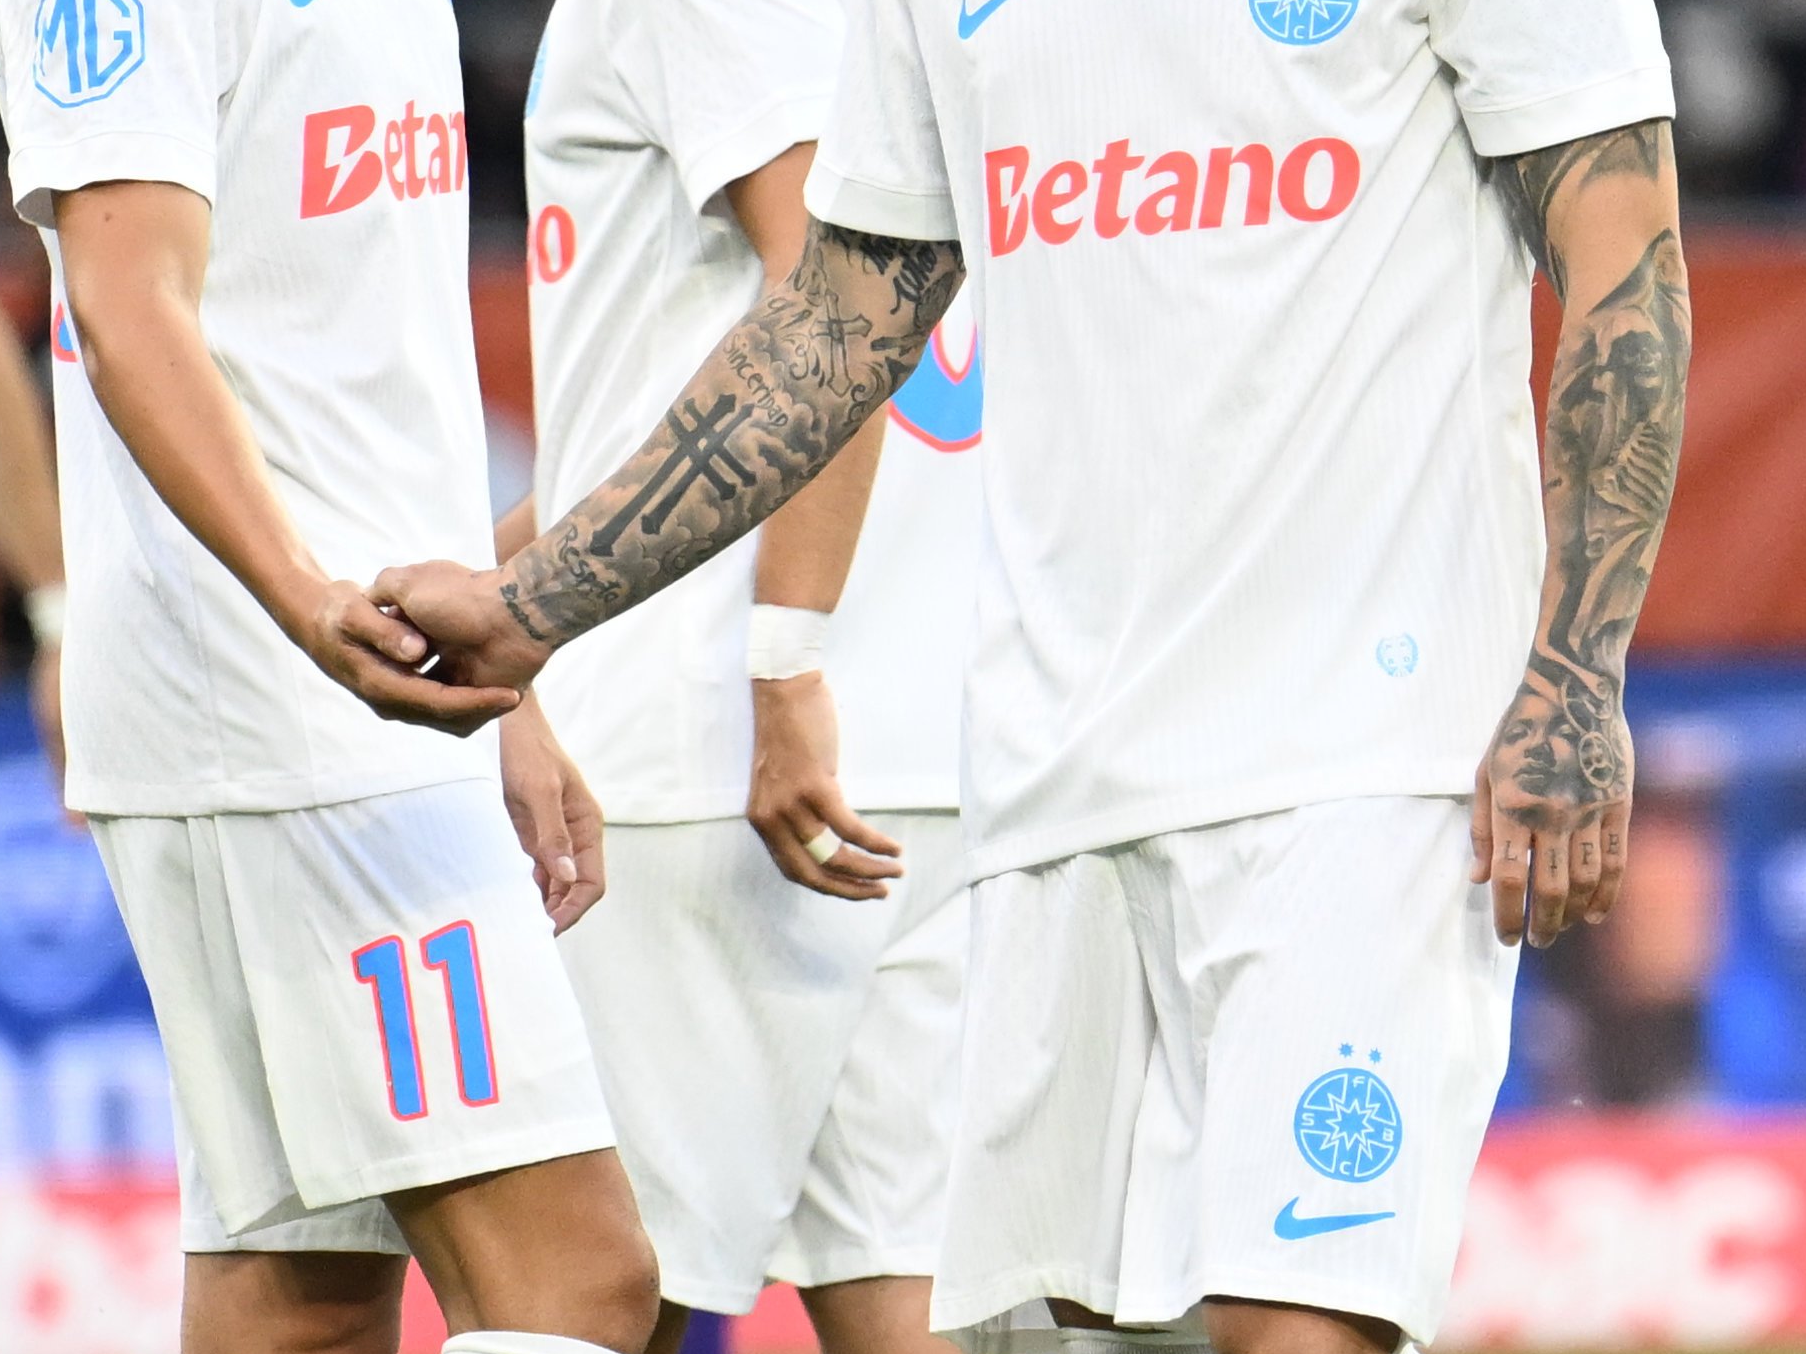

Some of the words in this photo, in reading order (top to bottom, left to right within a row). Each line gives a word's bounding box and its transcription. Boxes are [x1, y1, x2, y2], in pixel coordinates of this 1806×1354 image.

[300, 100, 466, 220] Betan
[984, 136, 1361, 258] Betano
[352, 919, 499, 1122] 11
